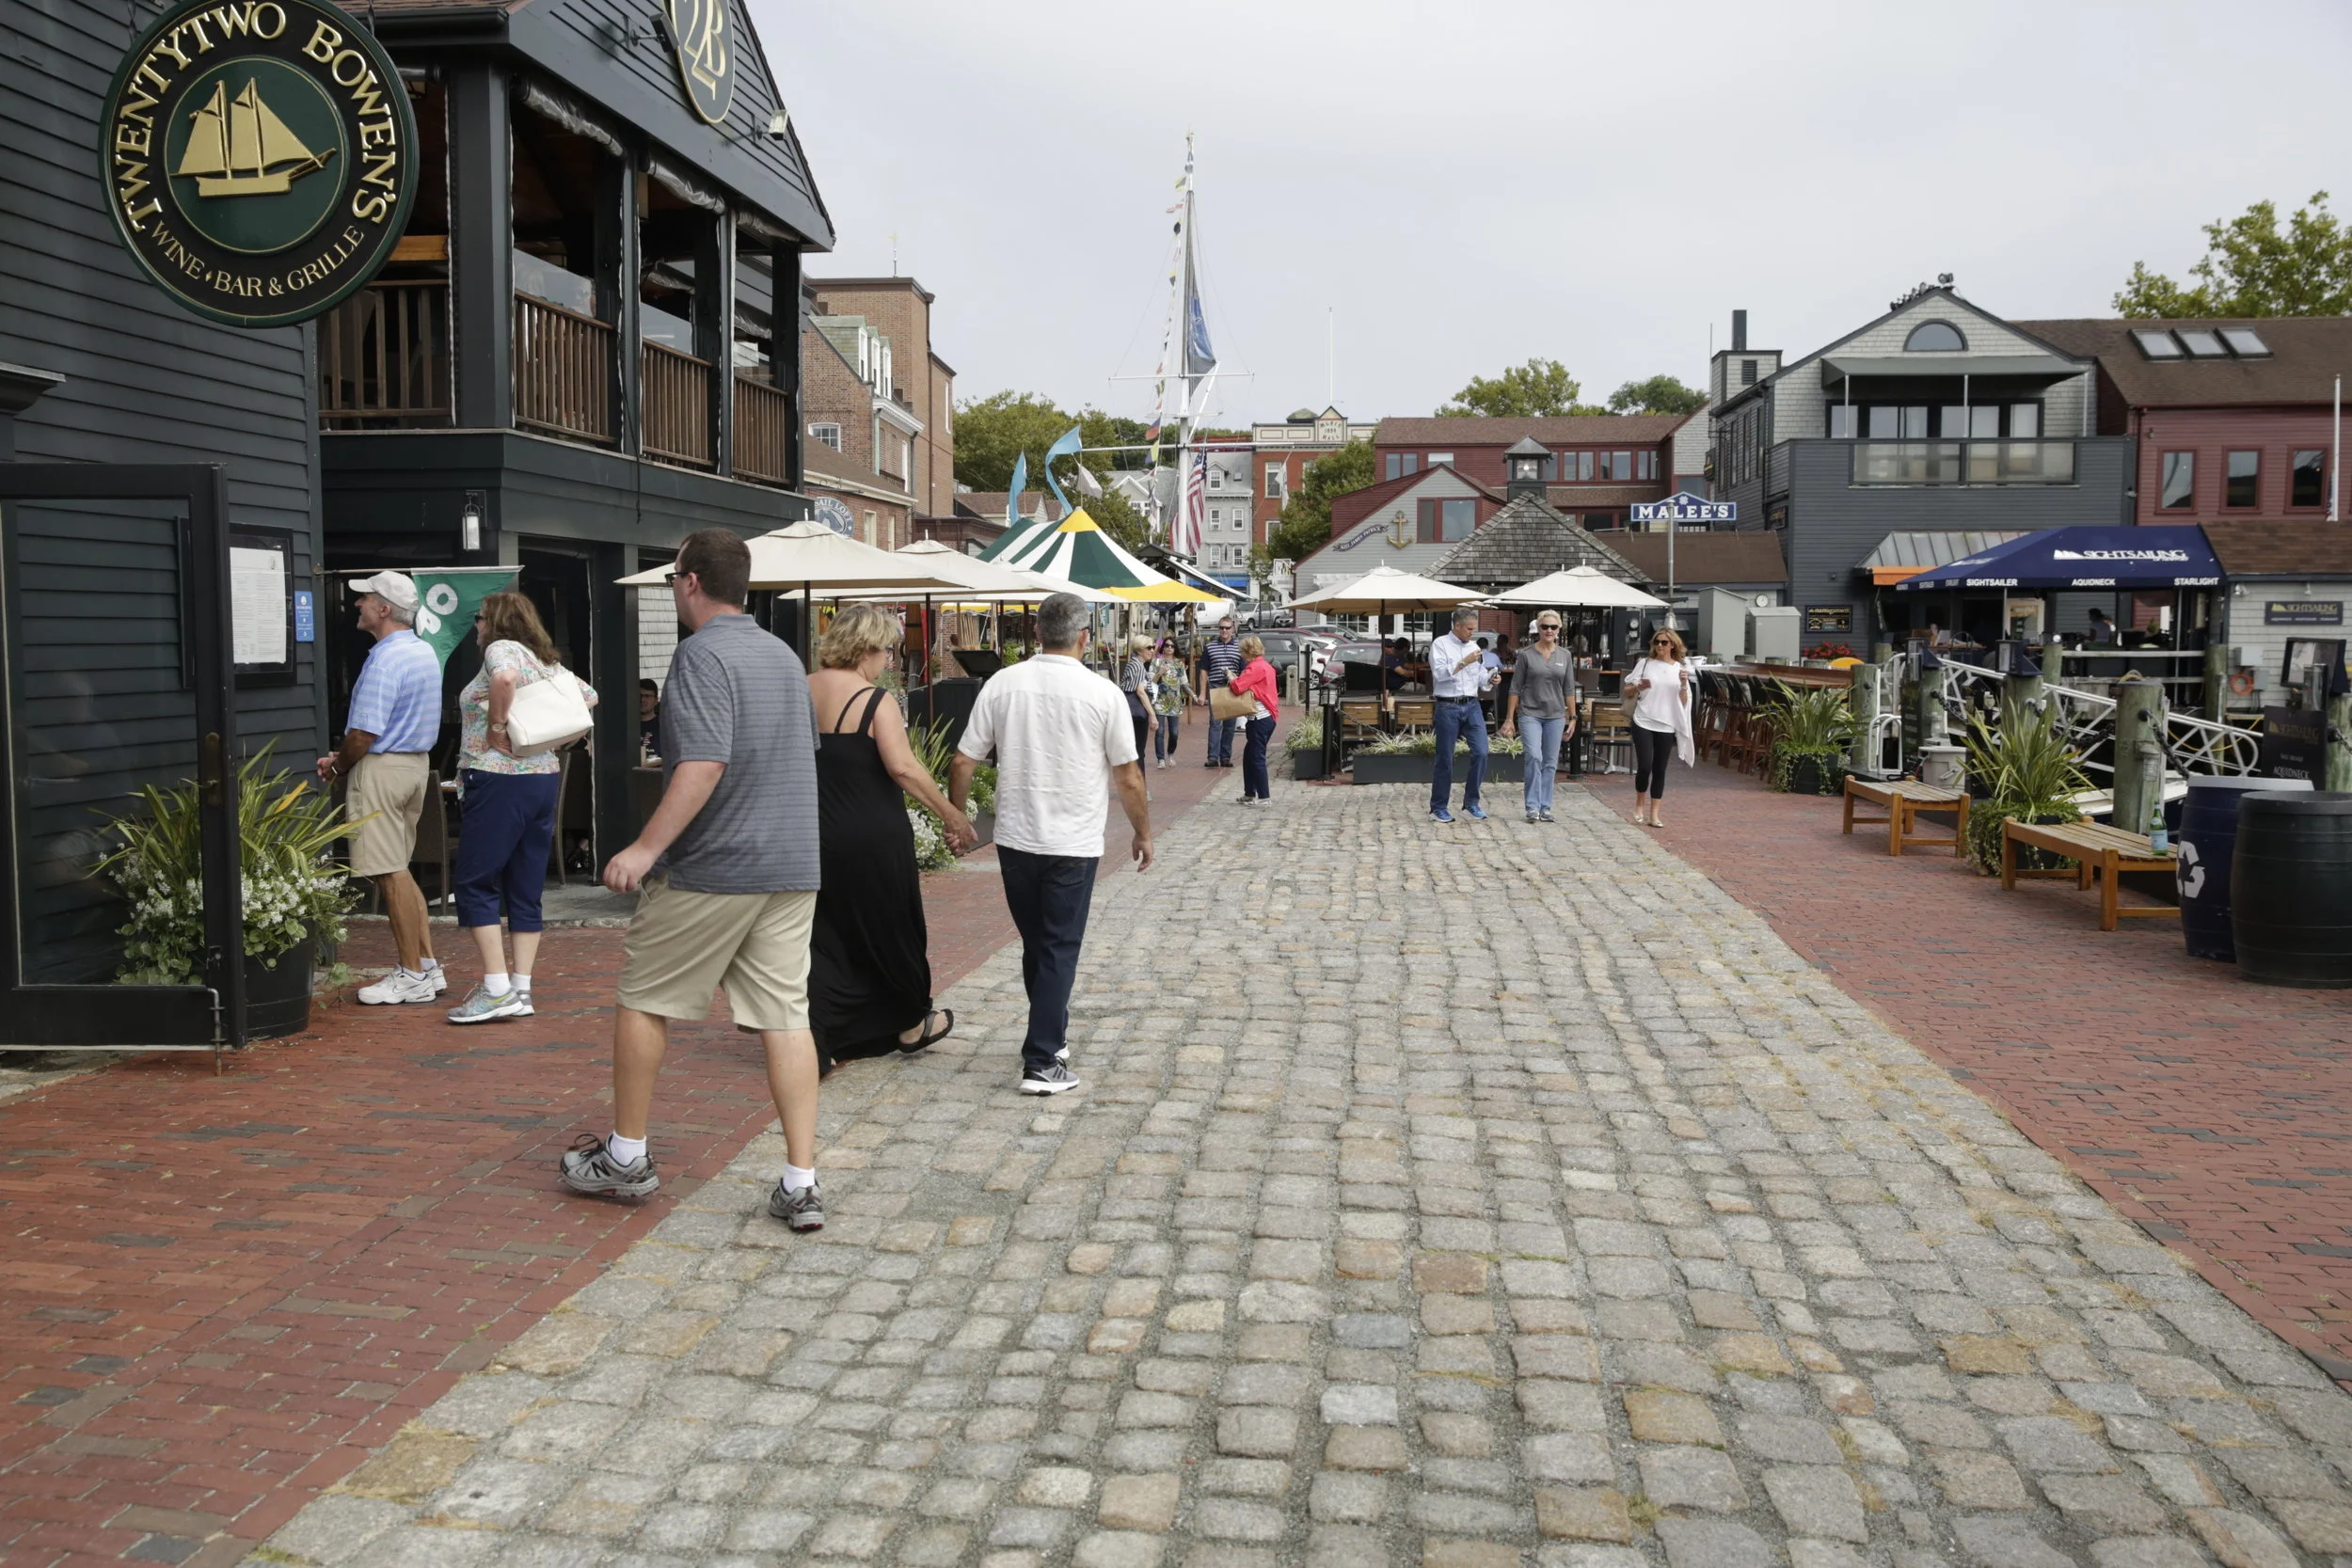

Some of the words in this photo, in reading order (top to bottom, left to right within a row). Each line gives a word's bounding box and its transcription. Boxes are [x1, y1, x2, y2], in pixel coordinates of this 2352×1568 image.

[115, 1, 286, 233] TWENTYTWO
[301, 19, 396, 225] BOWEN'S
[151, 220, 205, 280] WINE
[213, 270, 263, 296] BAR
[267, 277, 285, 296] &
[286, 225, 364, 291] GRILLE
[834, 502, 852, 521] LOFT
[1638, 505, 1729, 518] MALEE'S
[2083, 549, 2186, 560] SIGHTSAILING
[2174, 578, 2219, 586] STARLIGHT
